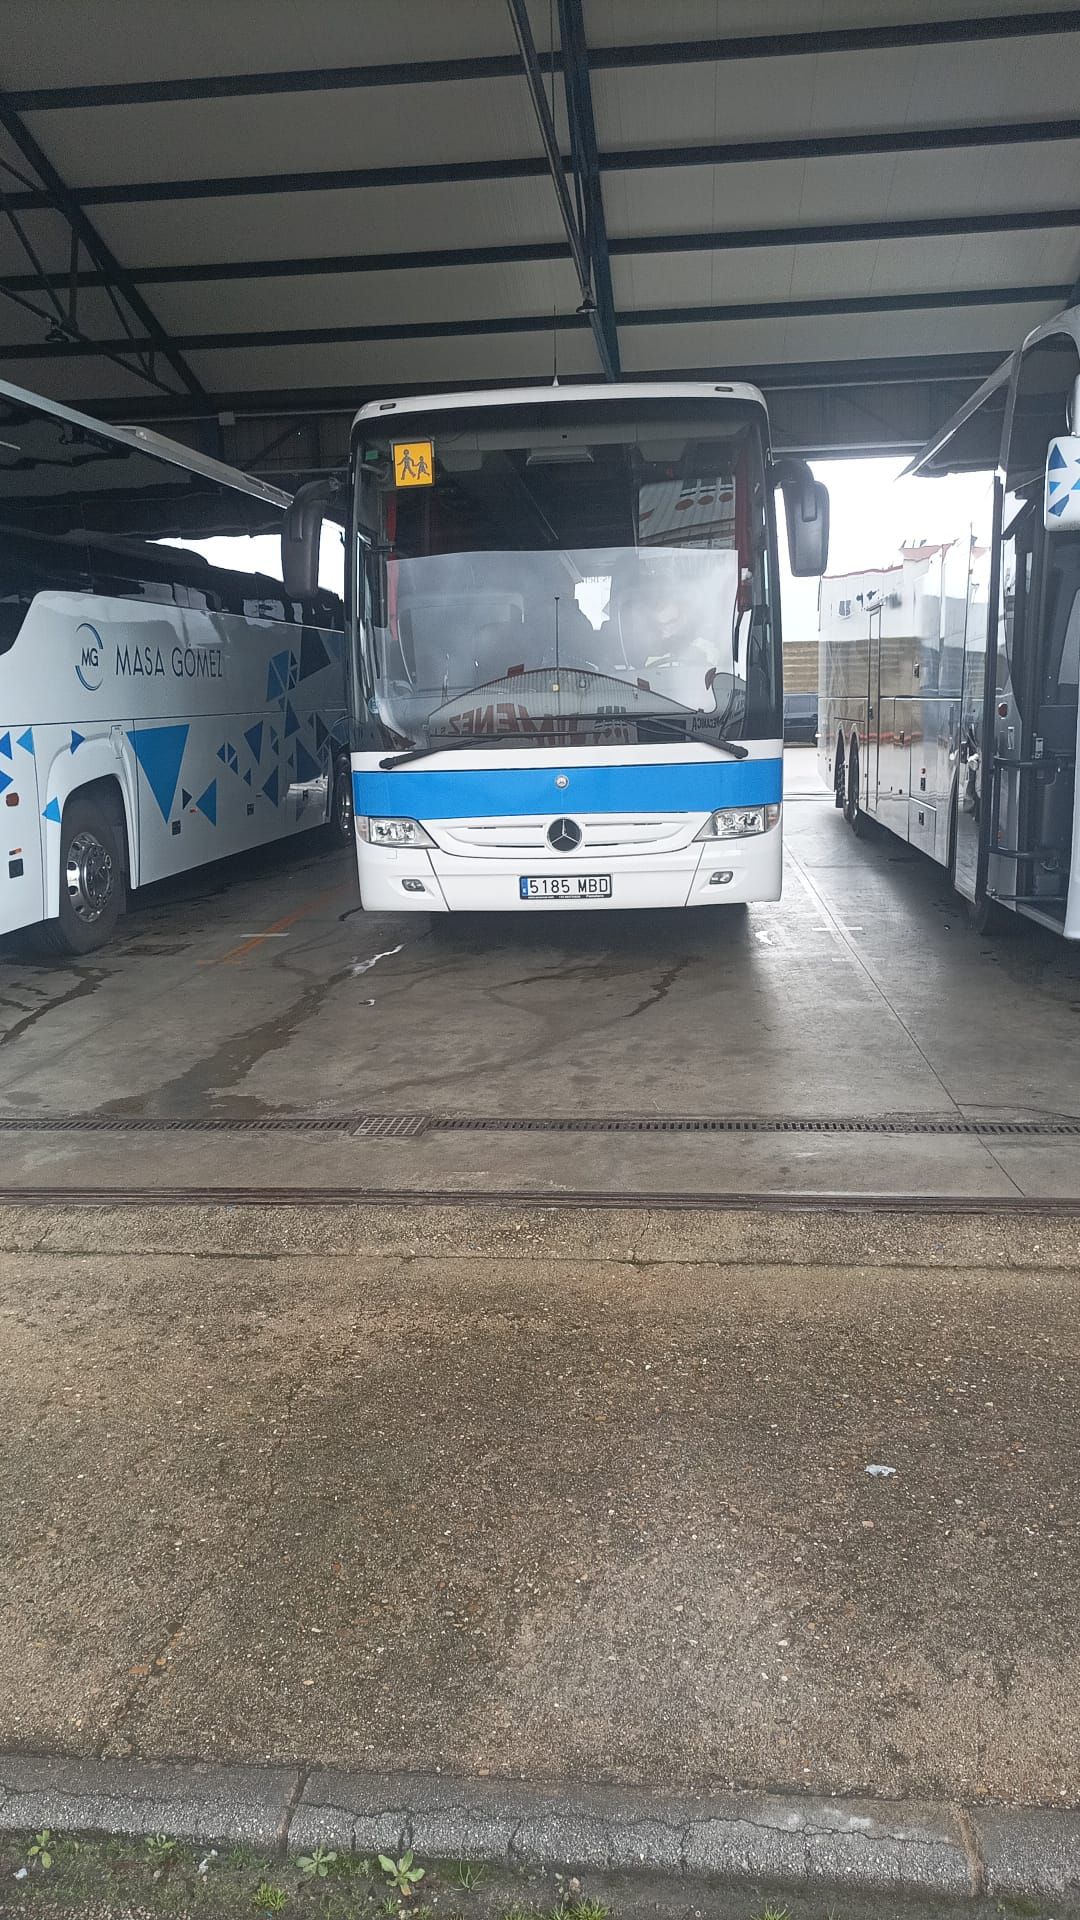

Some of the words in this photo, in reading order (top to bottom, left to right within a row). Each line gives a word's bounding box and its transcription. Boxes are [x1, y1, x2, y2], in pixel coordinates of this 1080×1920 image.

[81, 647, 99, 667] MG
[115, 643, 166, 676] MASA
[171, 643, 223, 678] GÓMEZ
[529, 879, 570, 894] 5185
[578, 878, 608, 893] MBD
